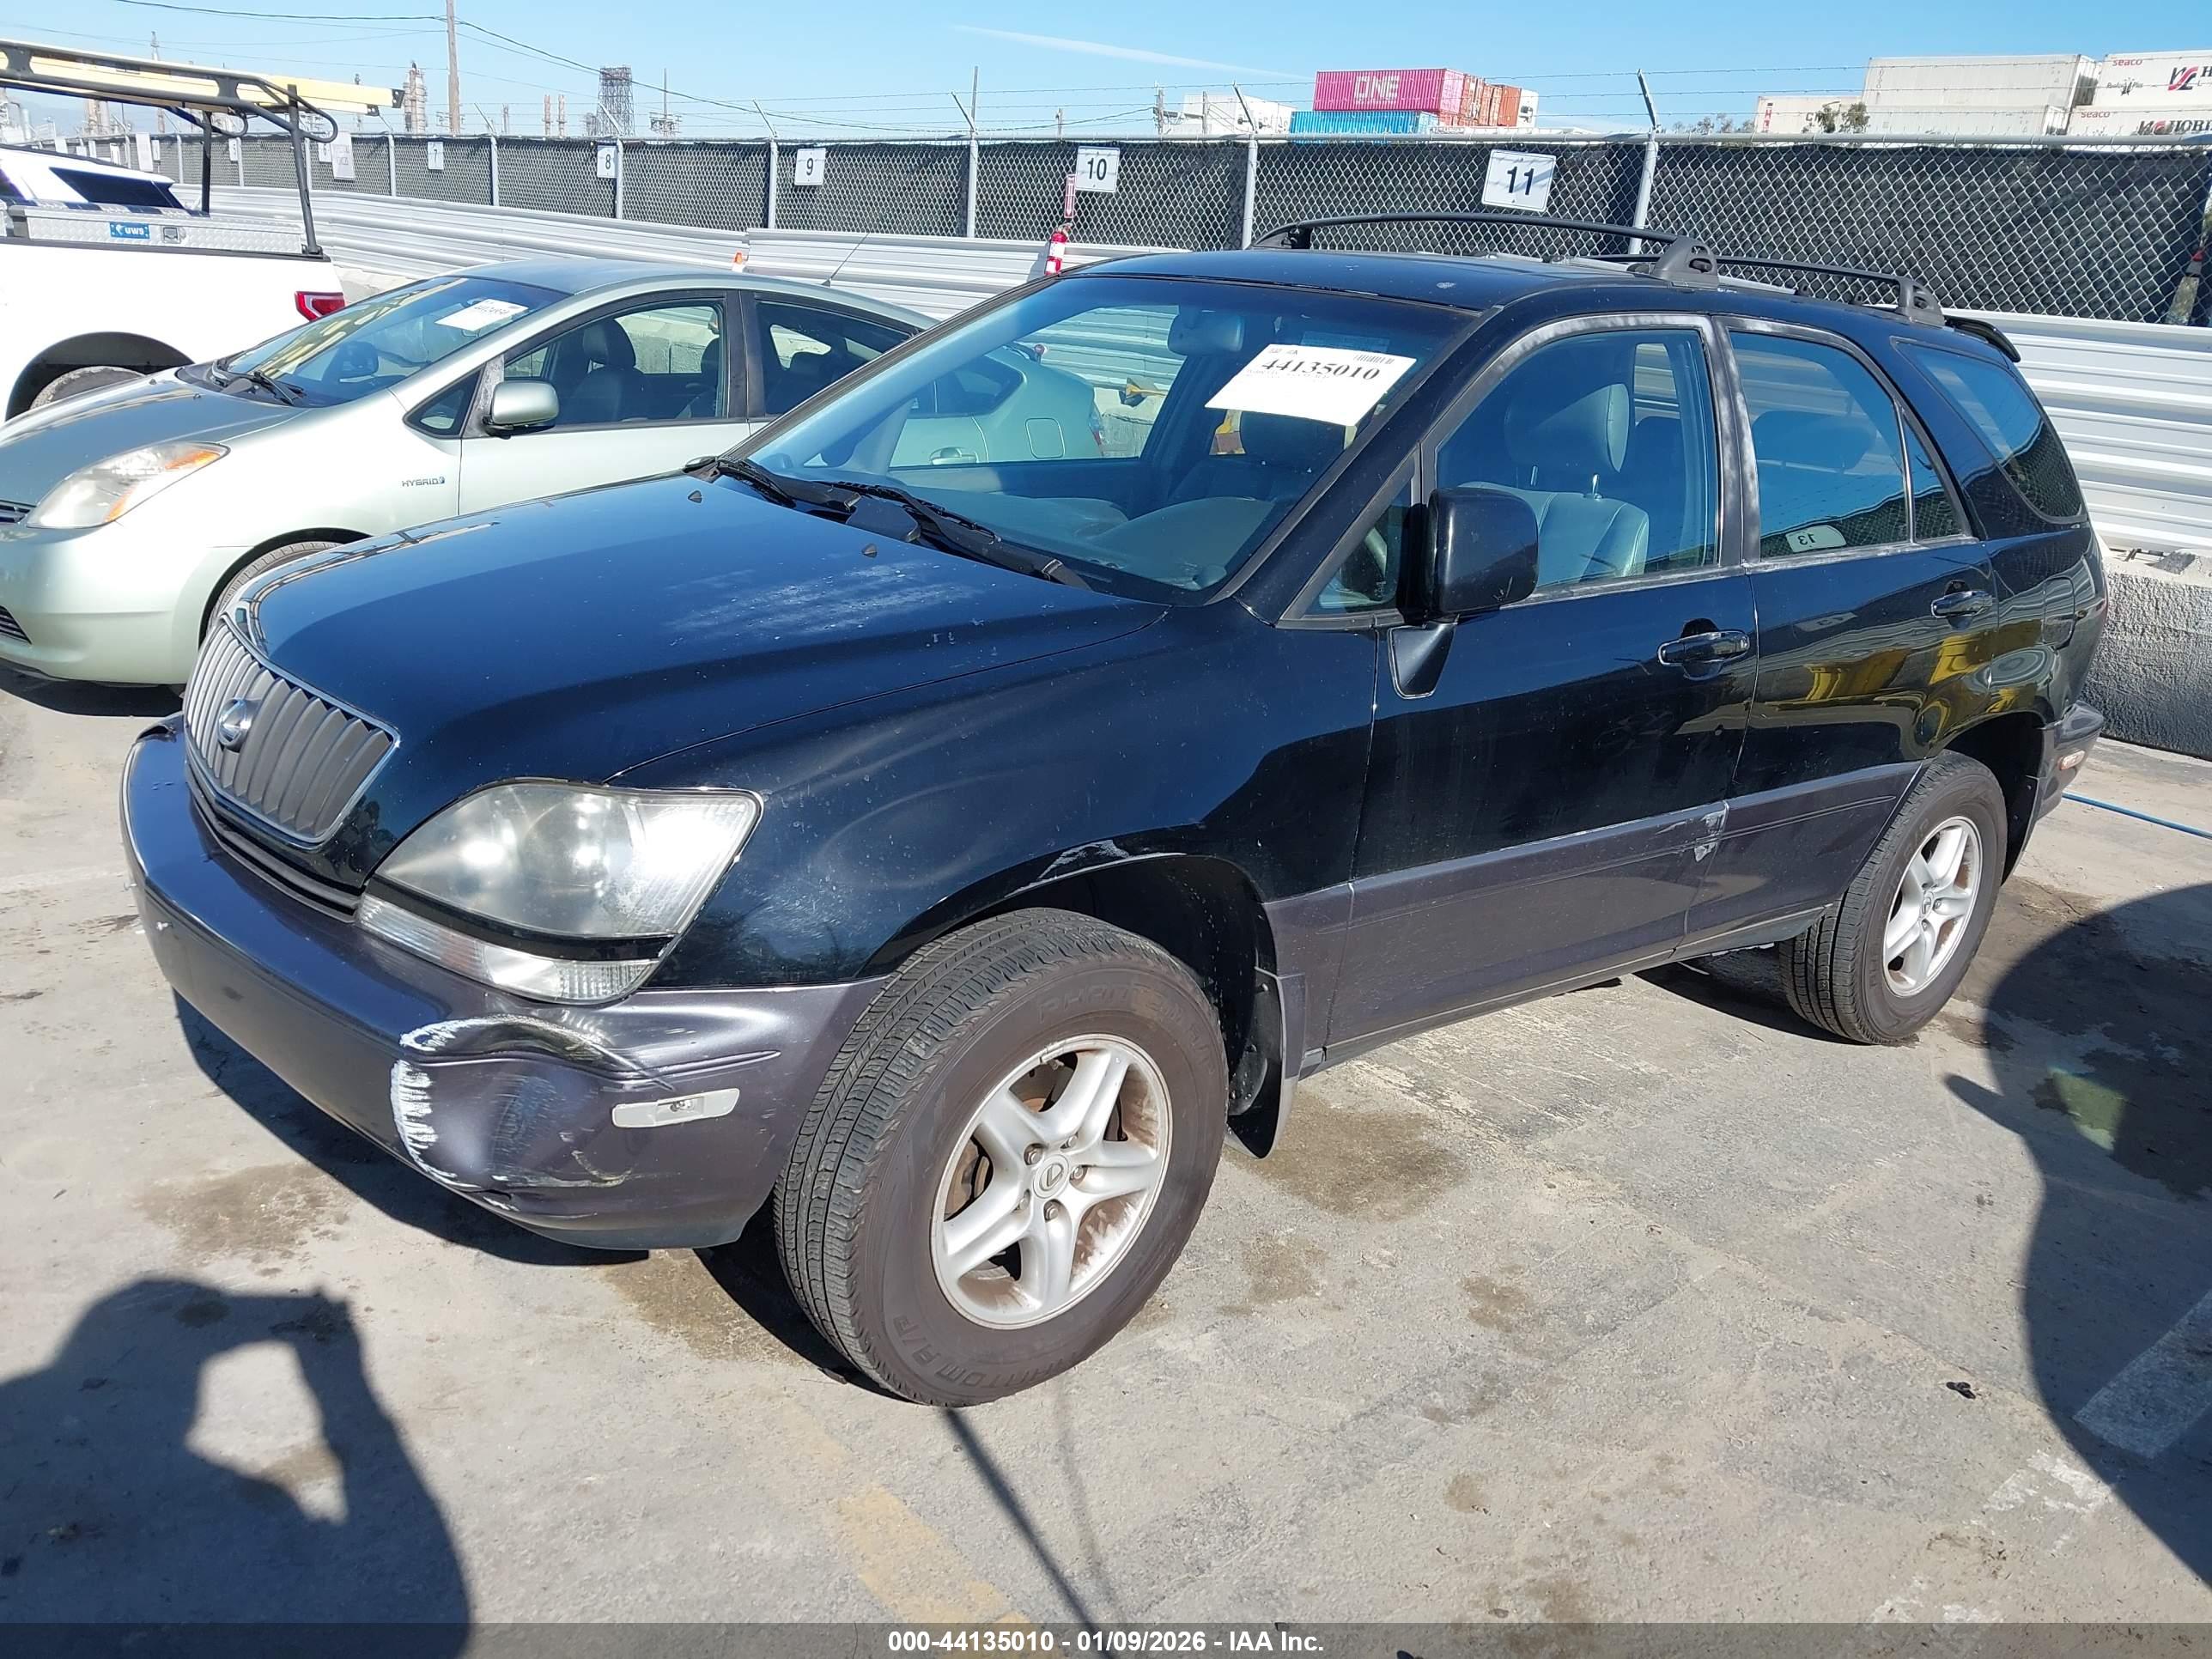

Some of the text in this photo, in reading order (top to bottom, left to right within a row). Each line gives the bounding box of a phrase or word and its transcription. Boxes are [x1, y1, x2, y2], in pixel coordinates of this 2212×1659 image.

[1354, 76, 1399, 99] ONE
[433, 149, 438, 165] 7
[605, 154, 611, 170] 8
[806, 158, 814, 176] 9
[1087, 157, 1108, 181] 10
[1507, 166, 1534, 196] 11
[1261, 359, 1381, 380] 44135010
[402, 477, 440, 487] HYBRID
